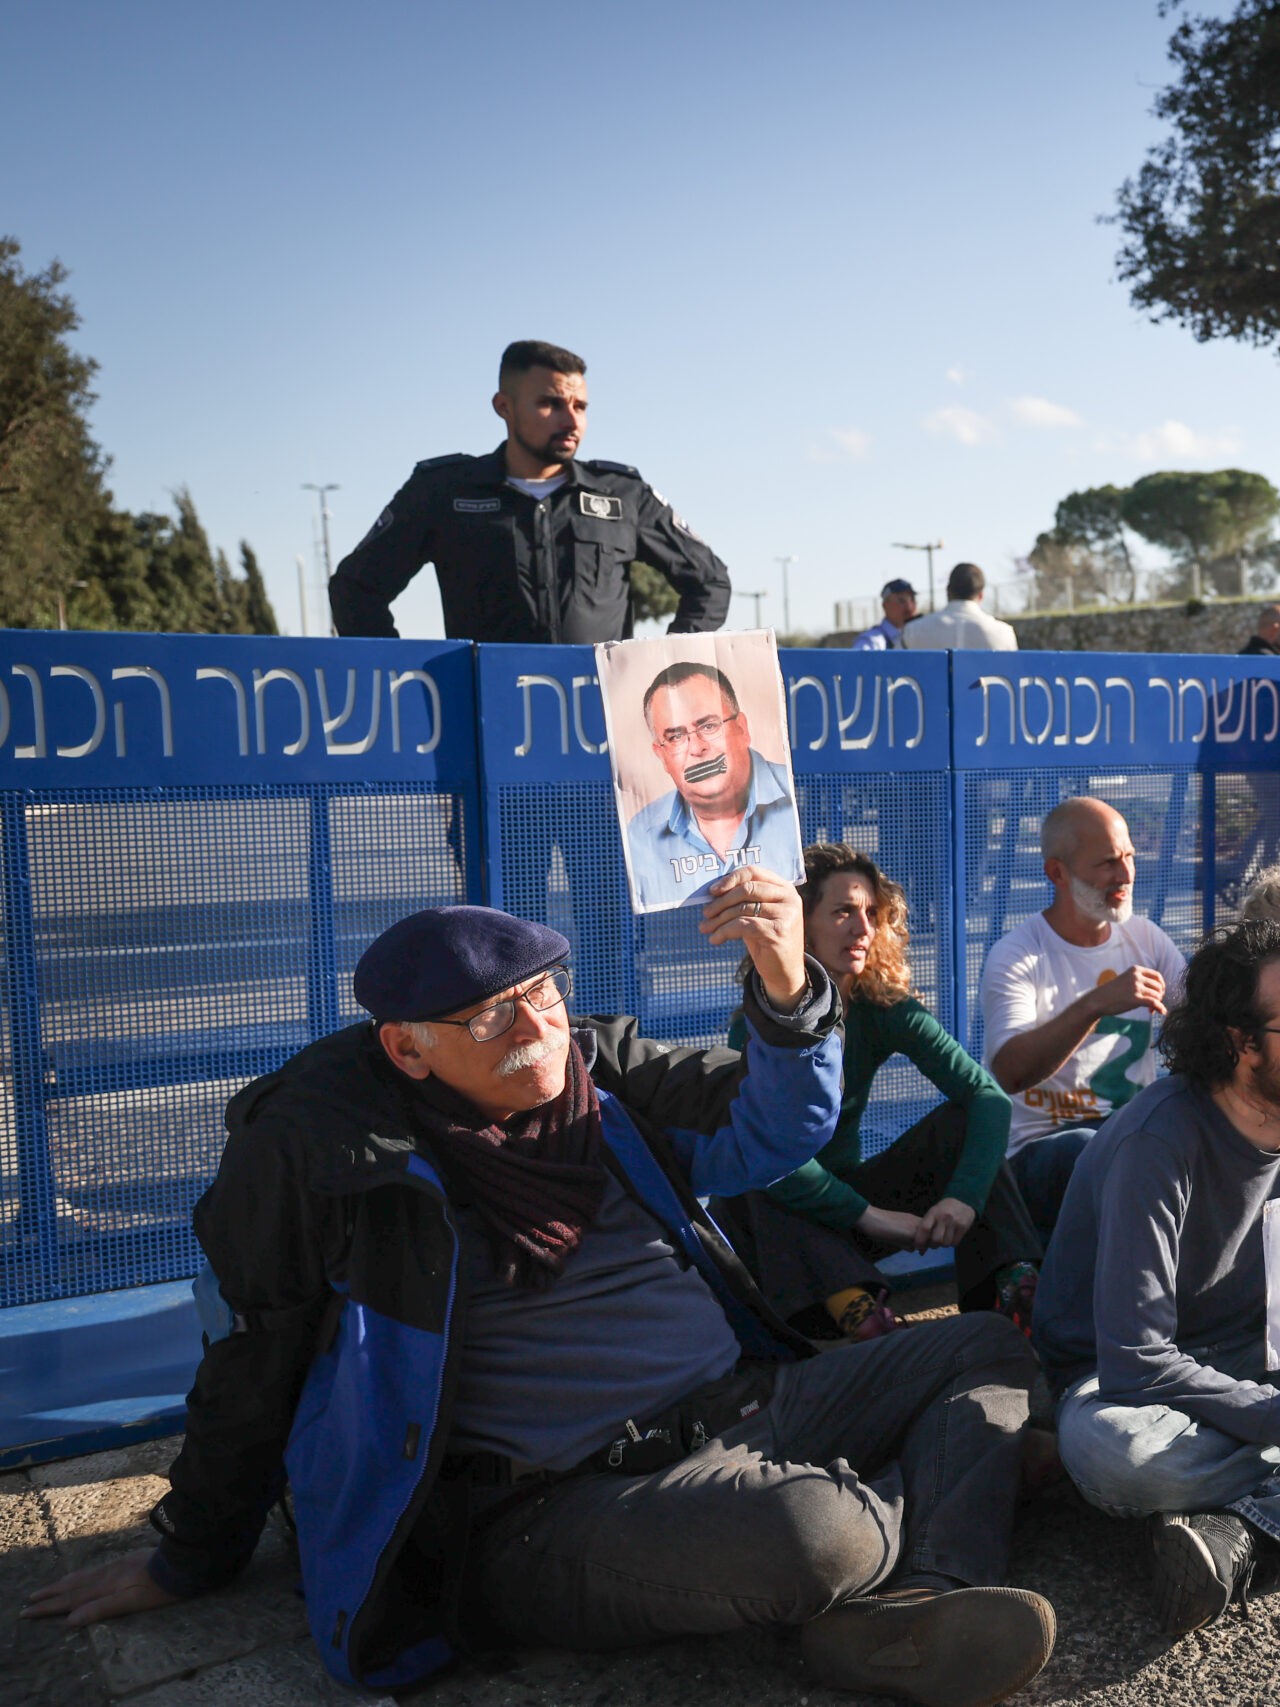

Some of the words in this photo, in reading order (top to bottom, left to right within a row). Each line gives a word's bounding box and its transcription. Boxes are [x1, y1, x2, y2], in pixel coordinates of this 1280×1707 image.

[0, 663, 174, 758] הכנ
[196, 666, 442, 757] משמר
[788, 674, 924, 751] משמ
[976, 675, 1135, 747] הכנסת
[1148, 677, 1279, 744] משמר
[669, 852, 720, 883] ביטן
[724, 845, 762, 868] דוד
